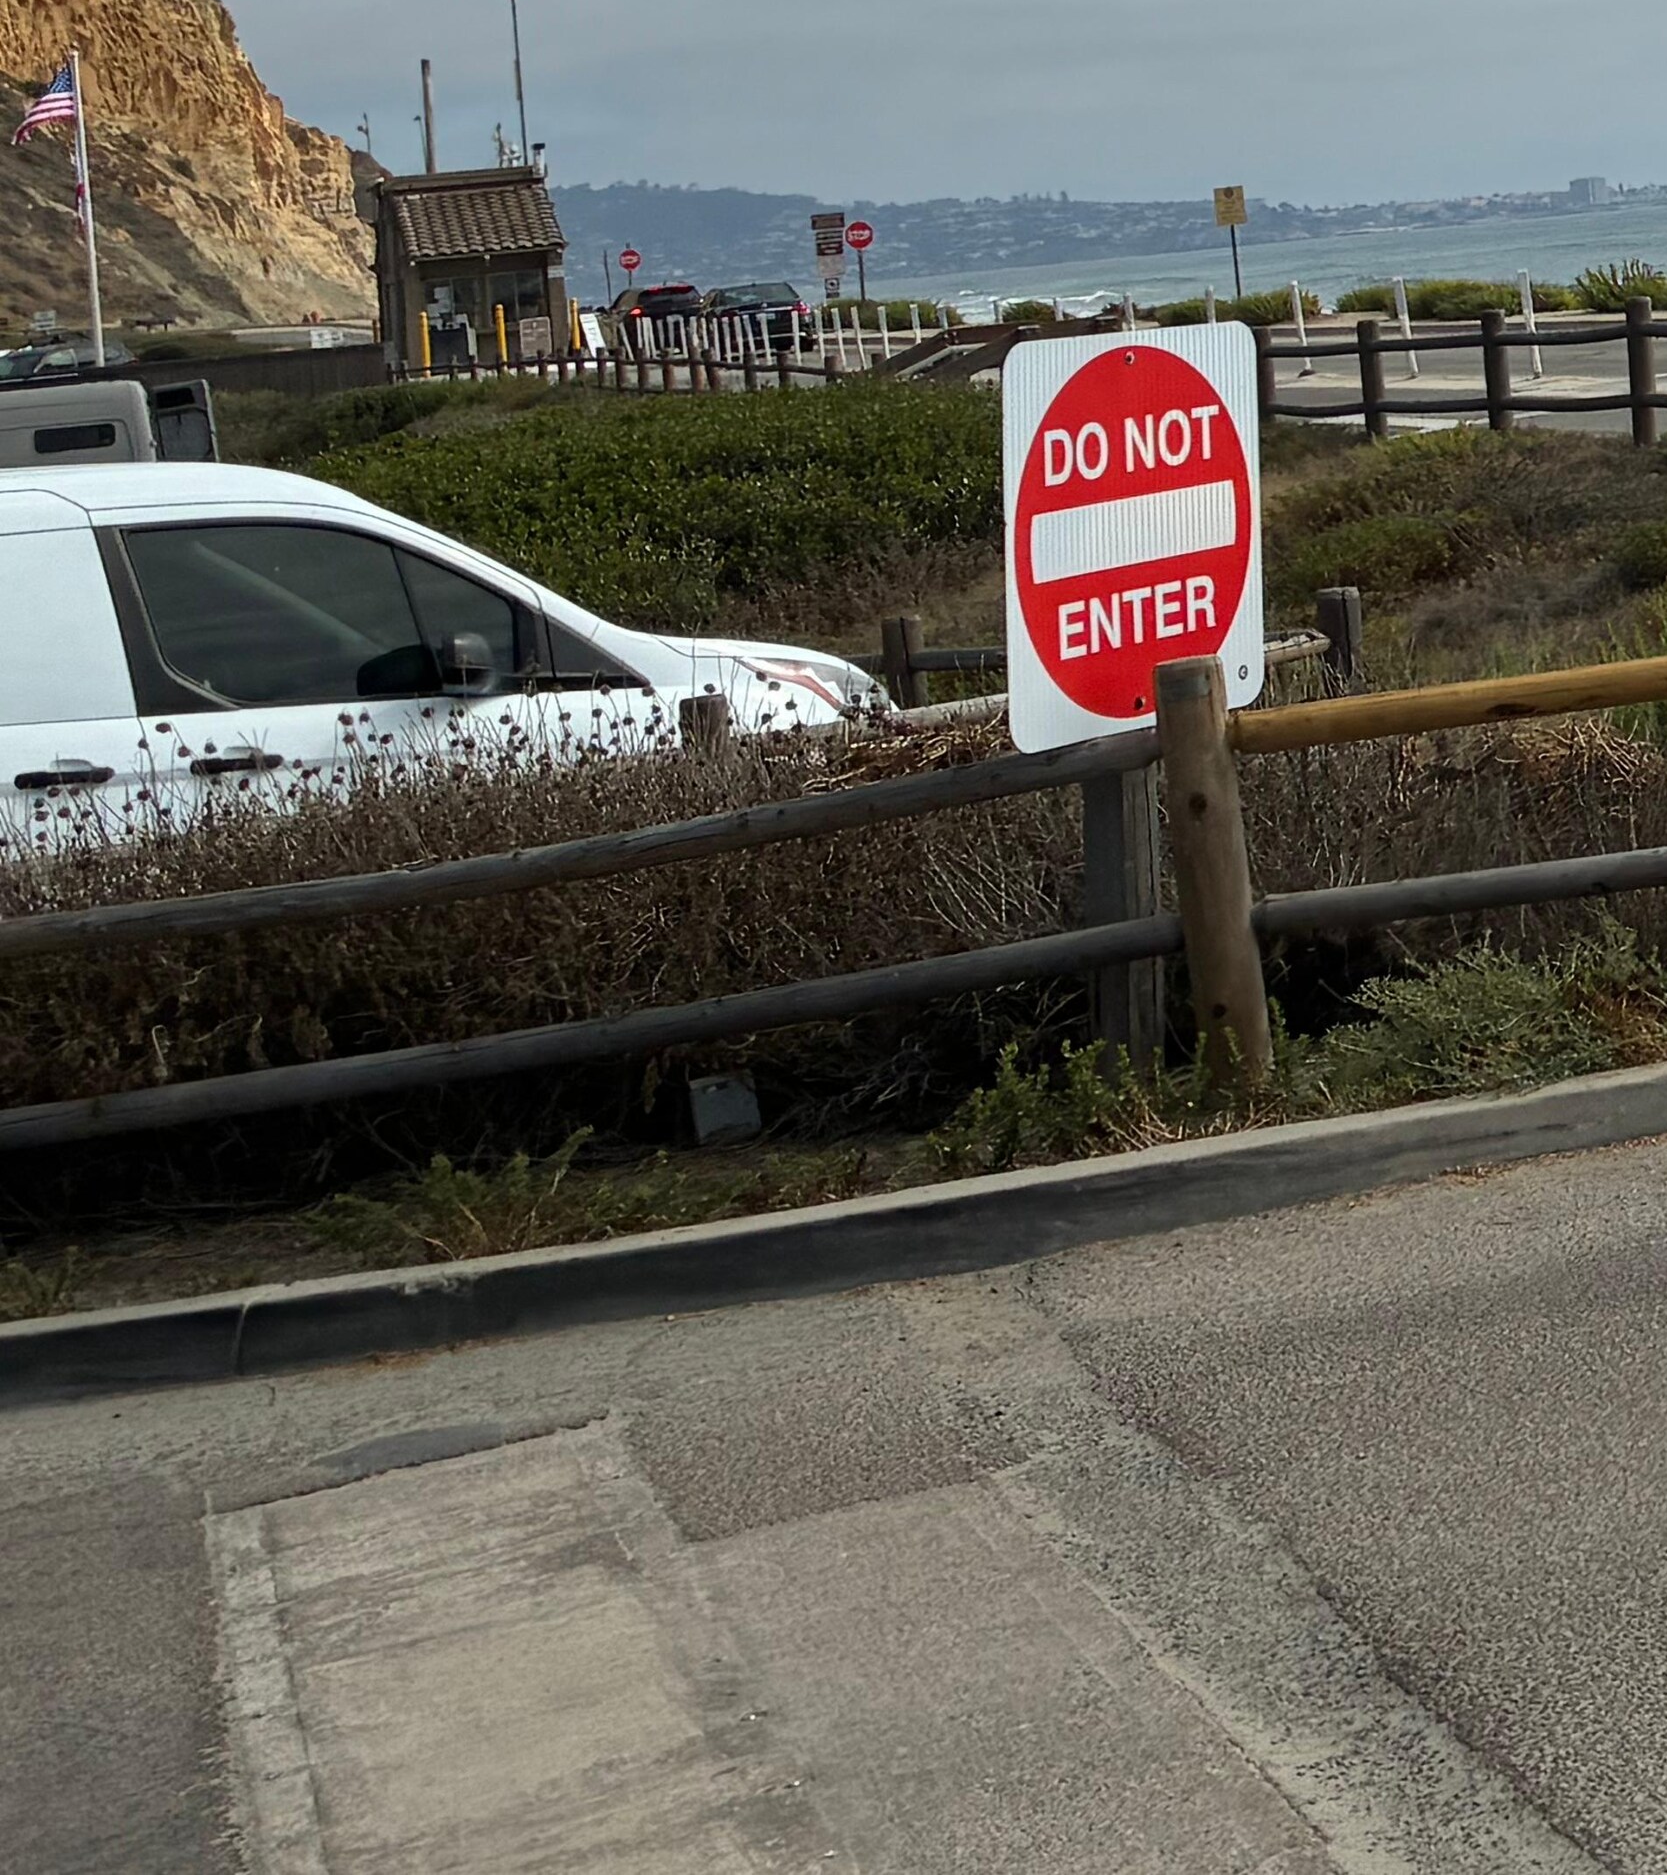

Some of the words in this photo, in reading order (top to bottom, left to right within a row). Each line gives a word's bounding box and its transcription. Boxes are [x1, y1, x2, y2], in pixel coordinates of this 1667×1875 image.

[1044, 421, 1109, 487] DO
[1124, 404, 1220, 473] NOT
[1058, 575, 1217, 661] ENTER
